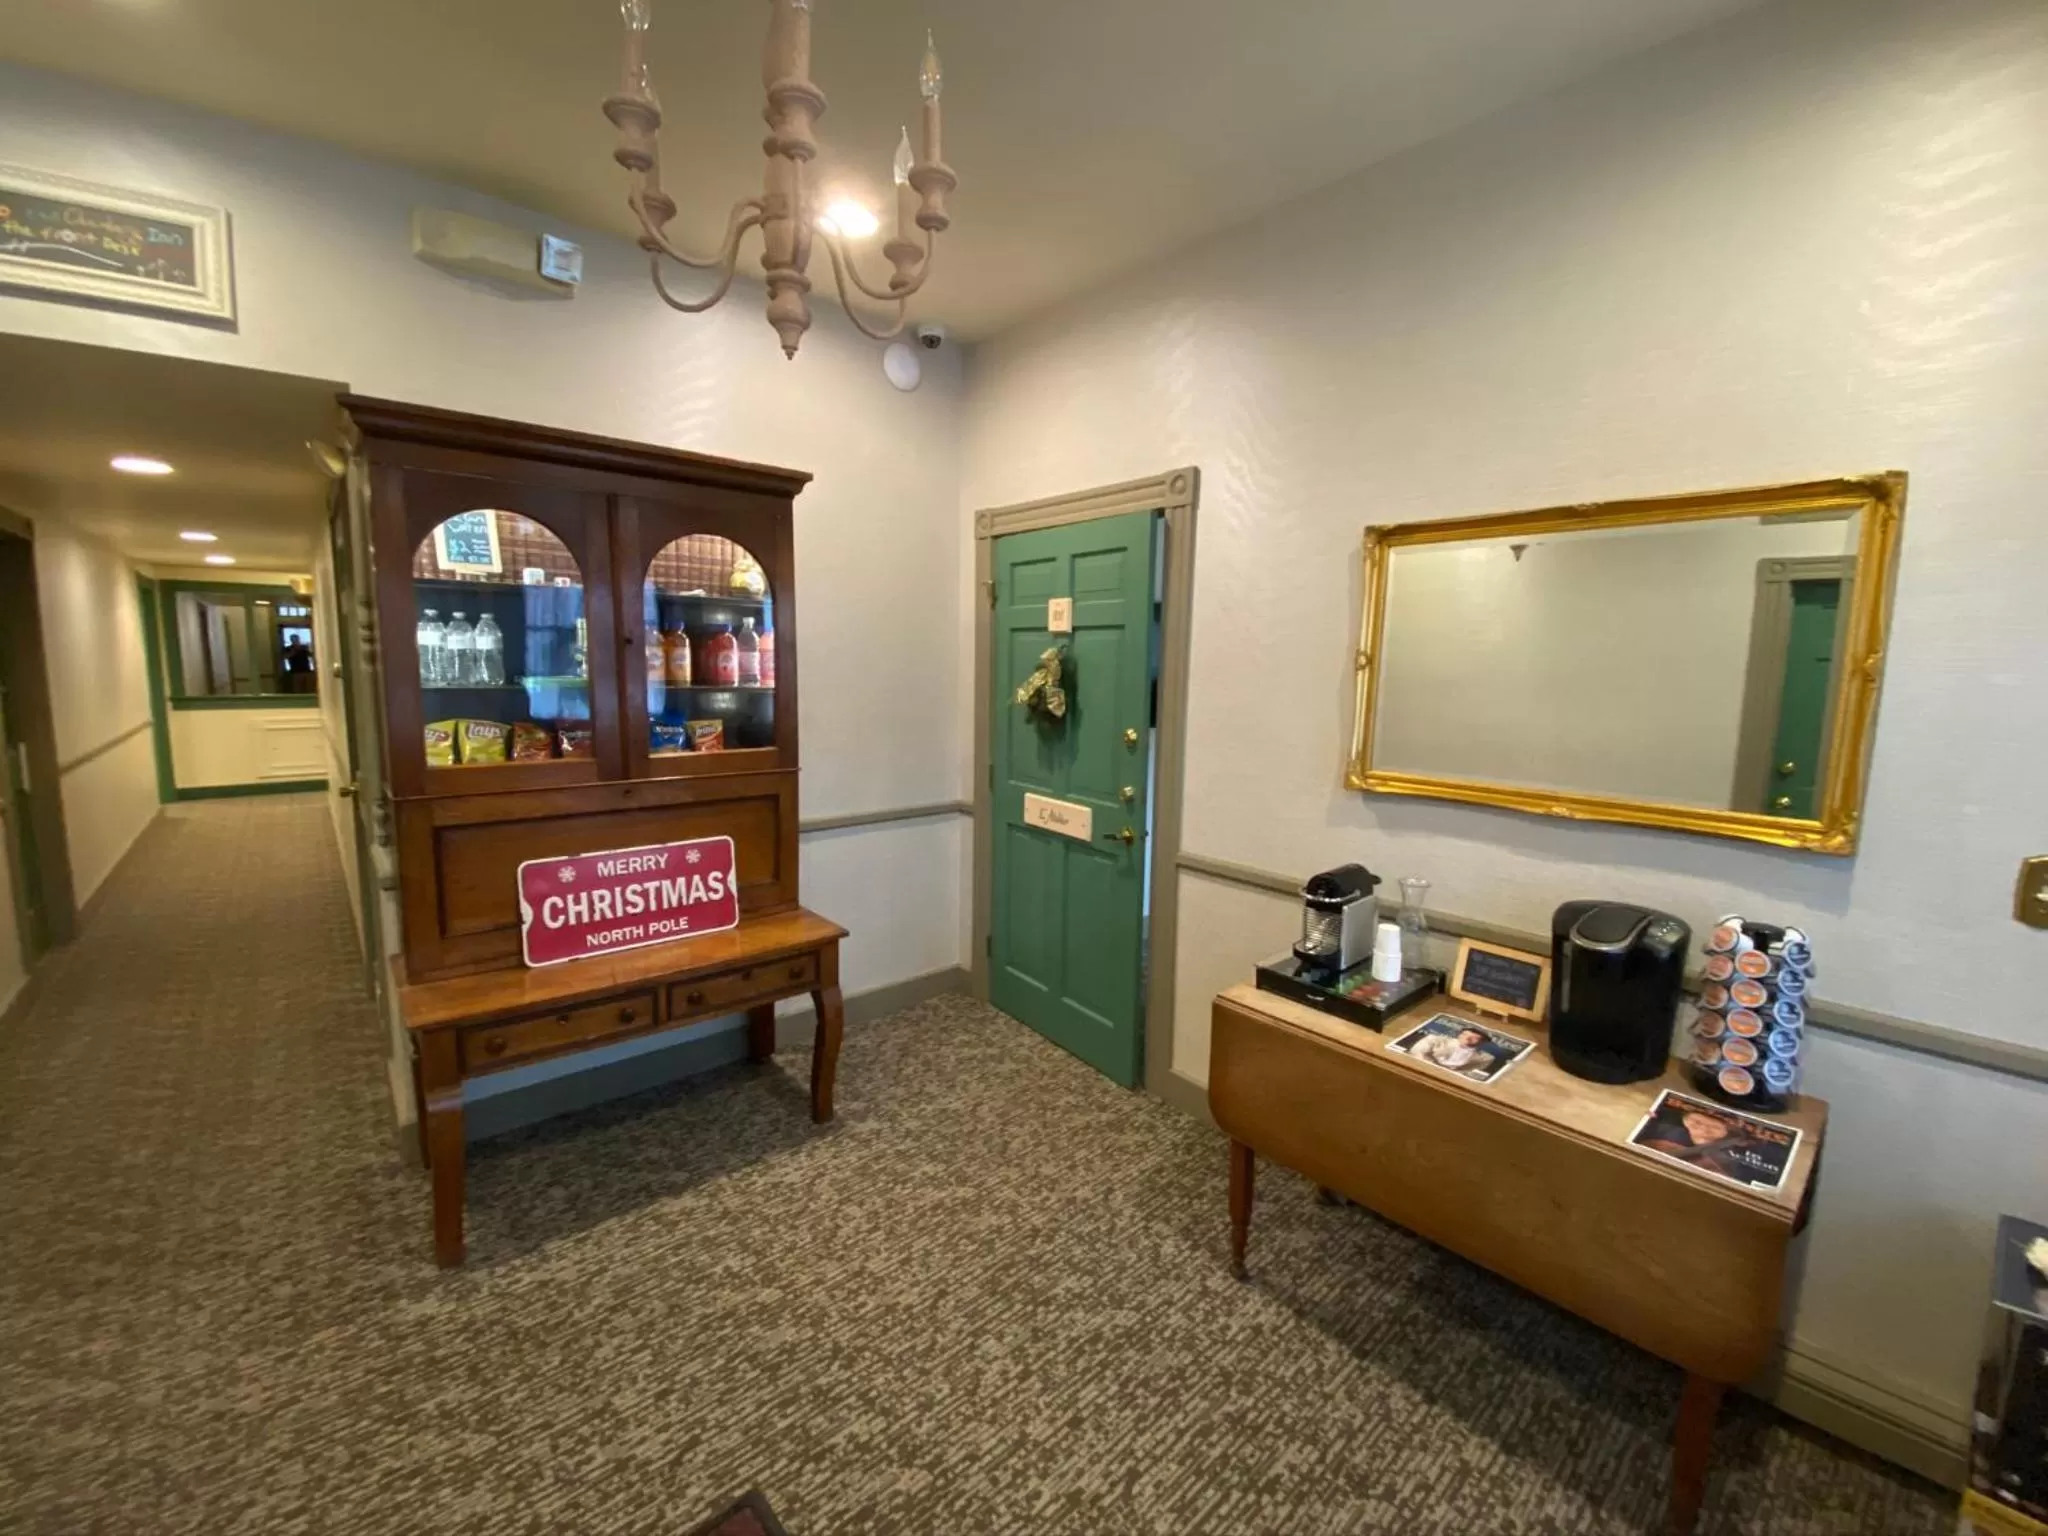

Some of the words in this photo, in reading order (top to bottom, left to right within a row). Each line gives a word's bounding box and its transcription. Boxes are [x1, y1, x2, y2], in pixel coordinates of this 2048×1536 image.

[597, 853, 669, 878] MERRY
[542, 871, 725, 930] CHRISTMAS
[586, 923, 644, 947] NORTH
[649, 916, 690, 936] POLE
